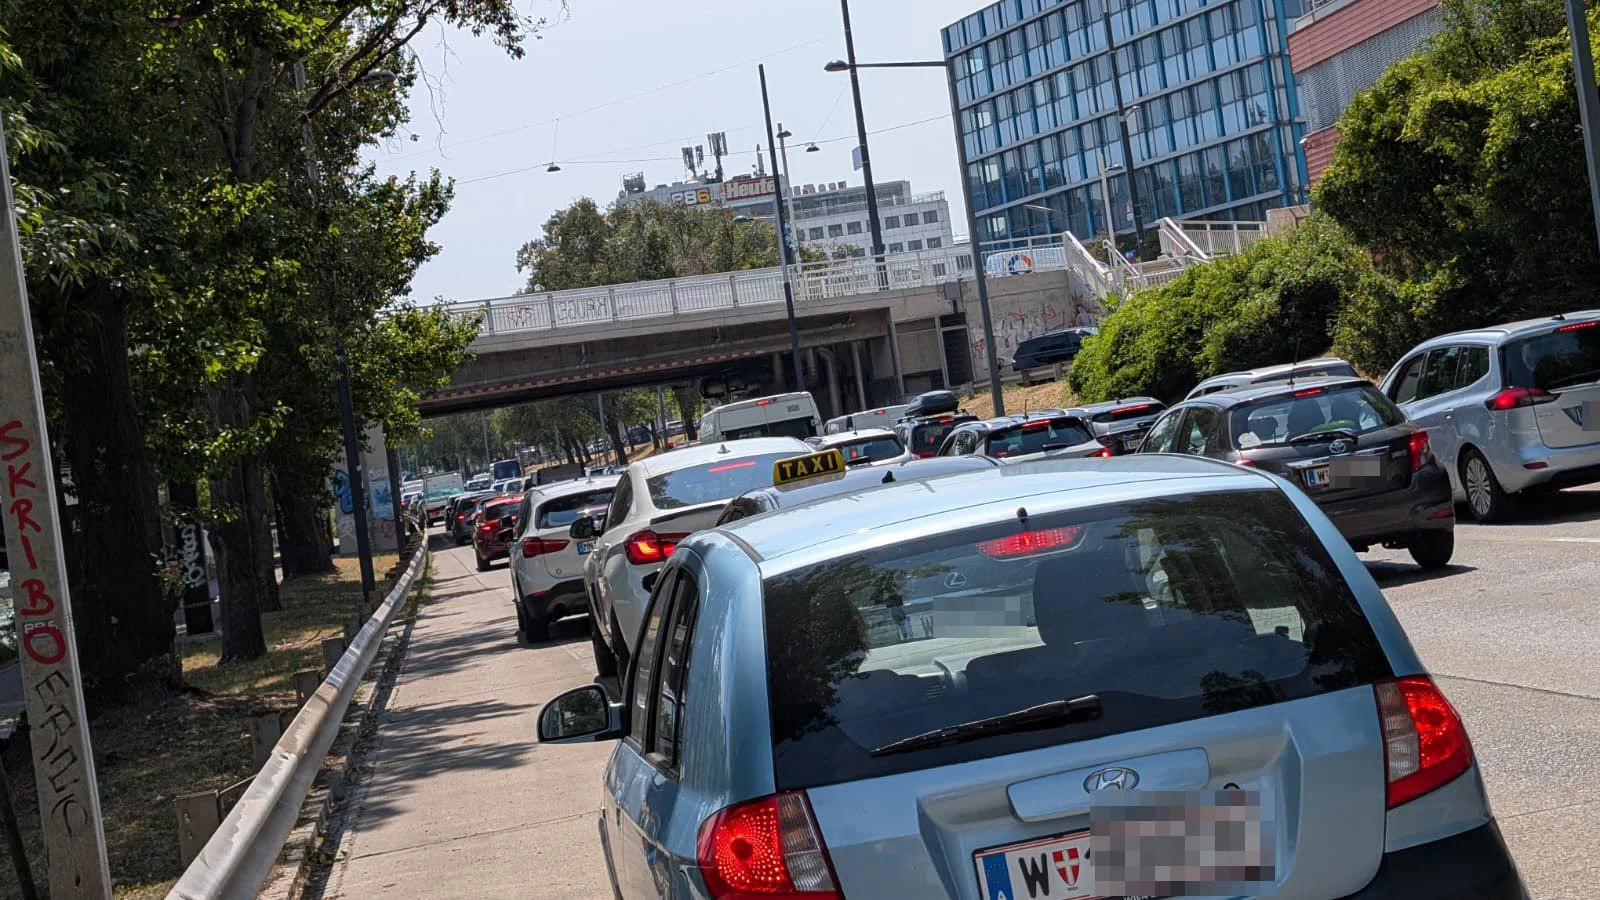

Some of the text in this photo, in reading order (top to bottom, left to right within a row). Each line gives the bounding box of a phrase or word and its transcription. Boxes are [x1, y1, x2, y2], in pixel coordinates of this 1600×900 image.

[781, 454, 834, 478] TAXI
[0, 420, 66, 665] SKRIBO
[1018, 852, 1050, 898] W
